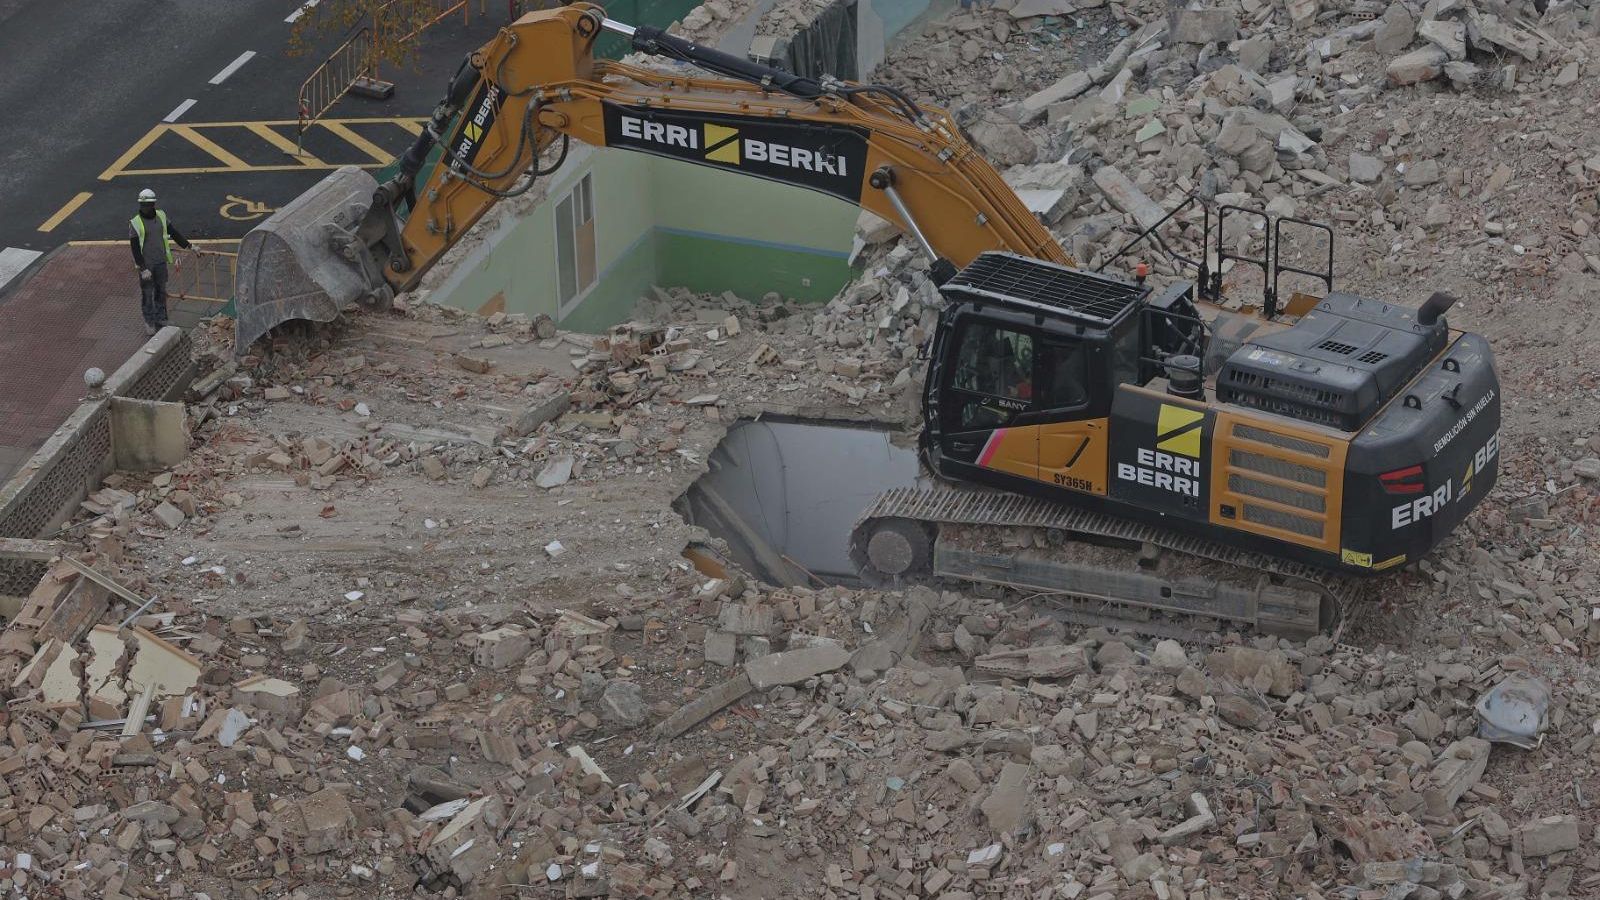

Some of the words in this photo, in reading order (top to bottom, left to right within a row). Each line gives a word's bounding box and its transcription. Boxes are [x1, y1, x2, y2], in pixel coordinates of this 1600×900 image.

[621, 115, 698, 150] ERRI
[744, 138, 847, 177] BERRI
[1466, 407, 1476, 422] SIN
[1474, 389, 1495, 413] HUELLA
[1117, 462, 1199, 497] BERRI
[1137, 447, 1200, 478] ERRI
[1054, 473, 1092, 491] SY365H
[1391, 478, 1452, 530] ERRI
